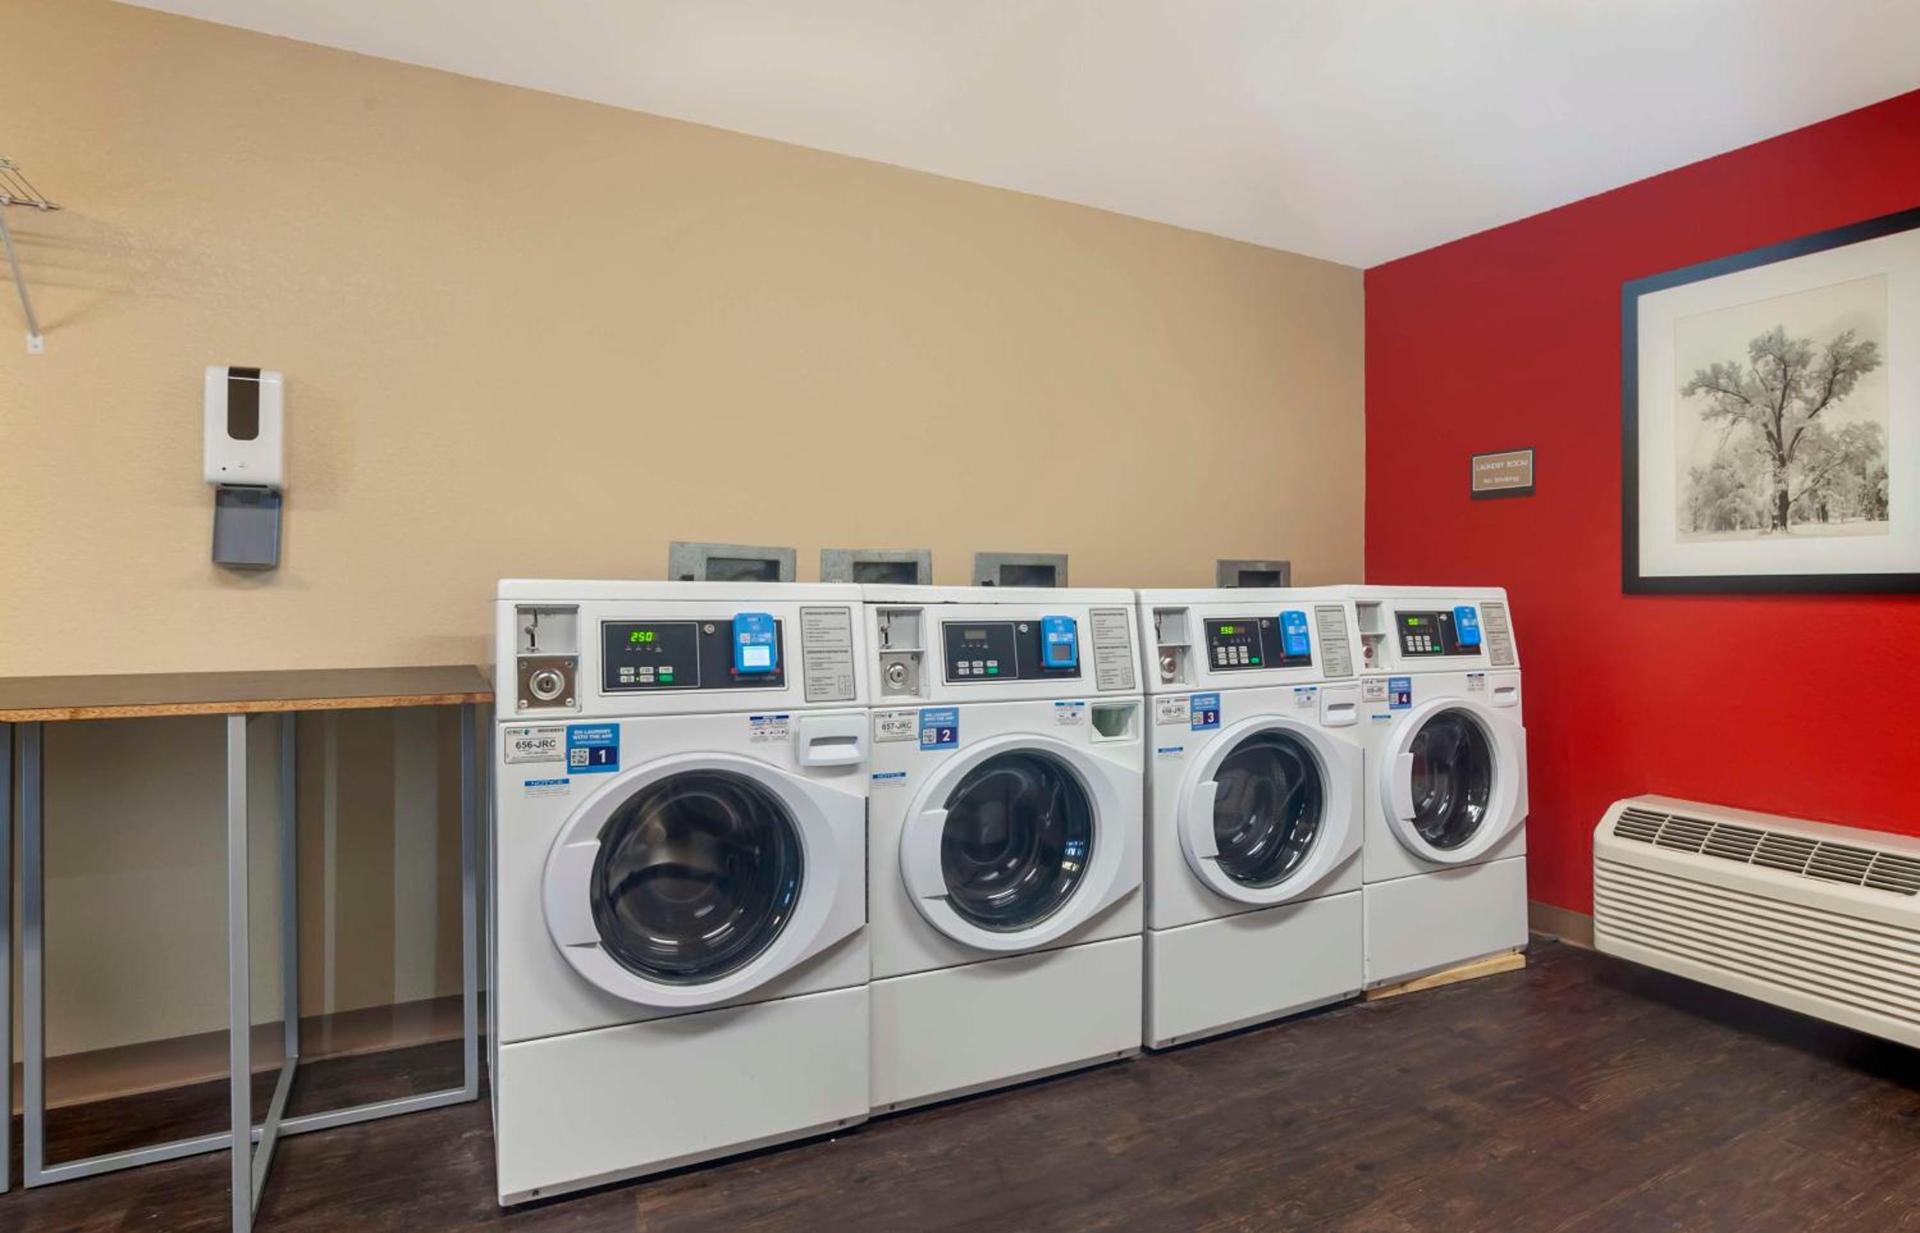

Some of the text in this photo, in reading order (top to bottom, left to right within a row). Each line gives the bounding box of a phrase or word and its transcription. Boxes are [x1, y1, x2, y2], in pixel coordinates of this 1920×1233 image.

[630, 631, 654, 642] 250
[1401, 693, 1408, 703] 4
[1207, 712, 1215, 723] 3
[942, 729, 951, 742] 2
[515, 740, 557, 750] 656-JRC
[598, 749, 607, 763] 1
